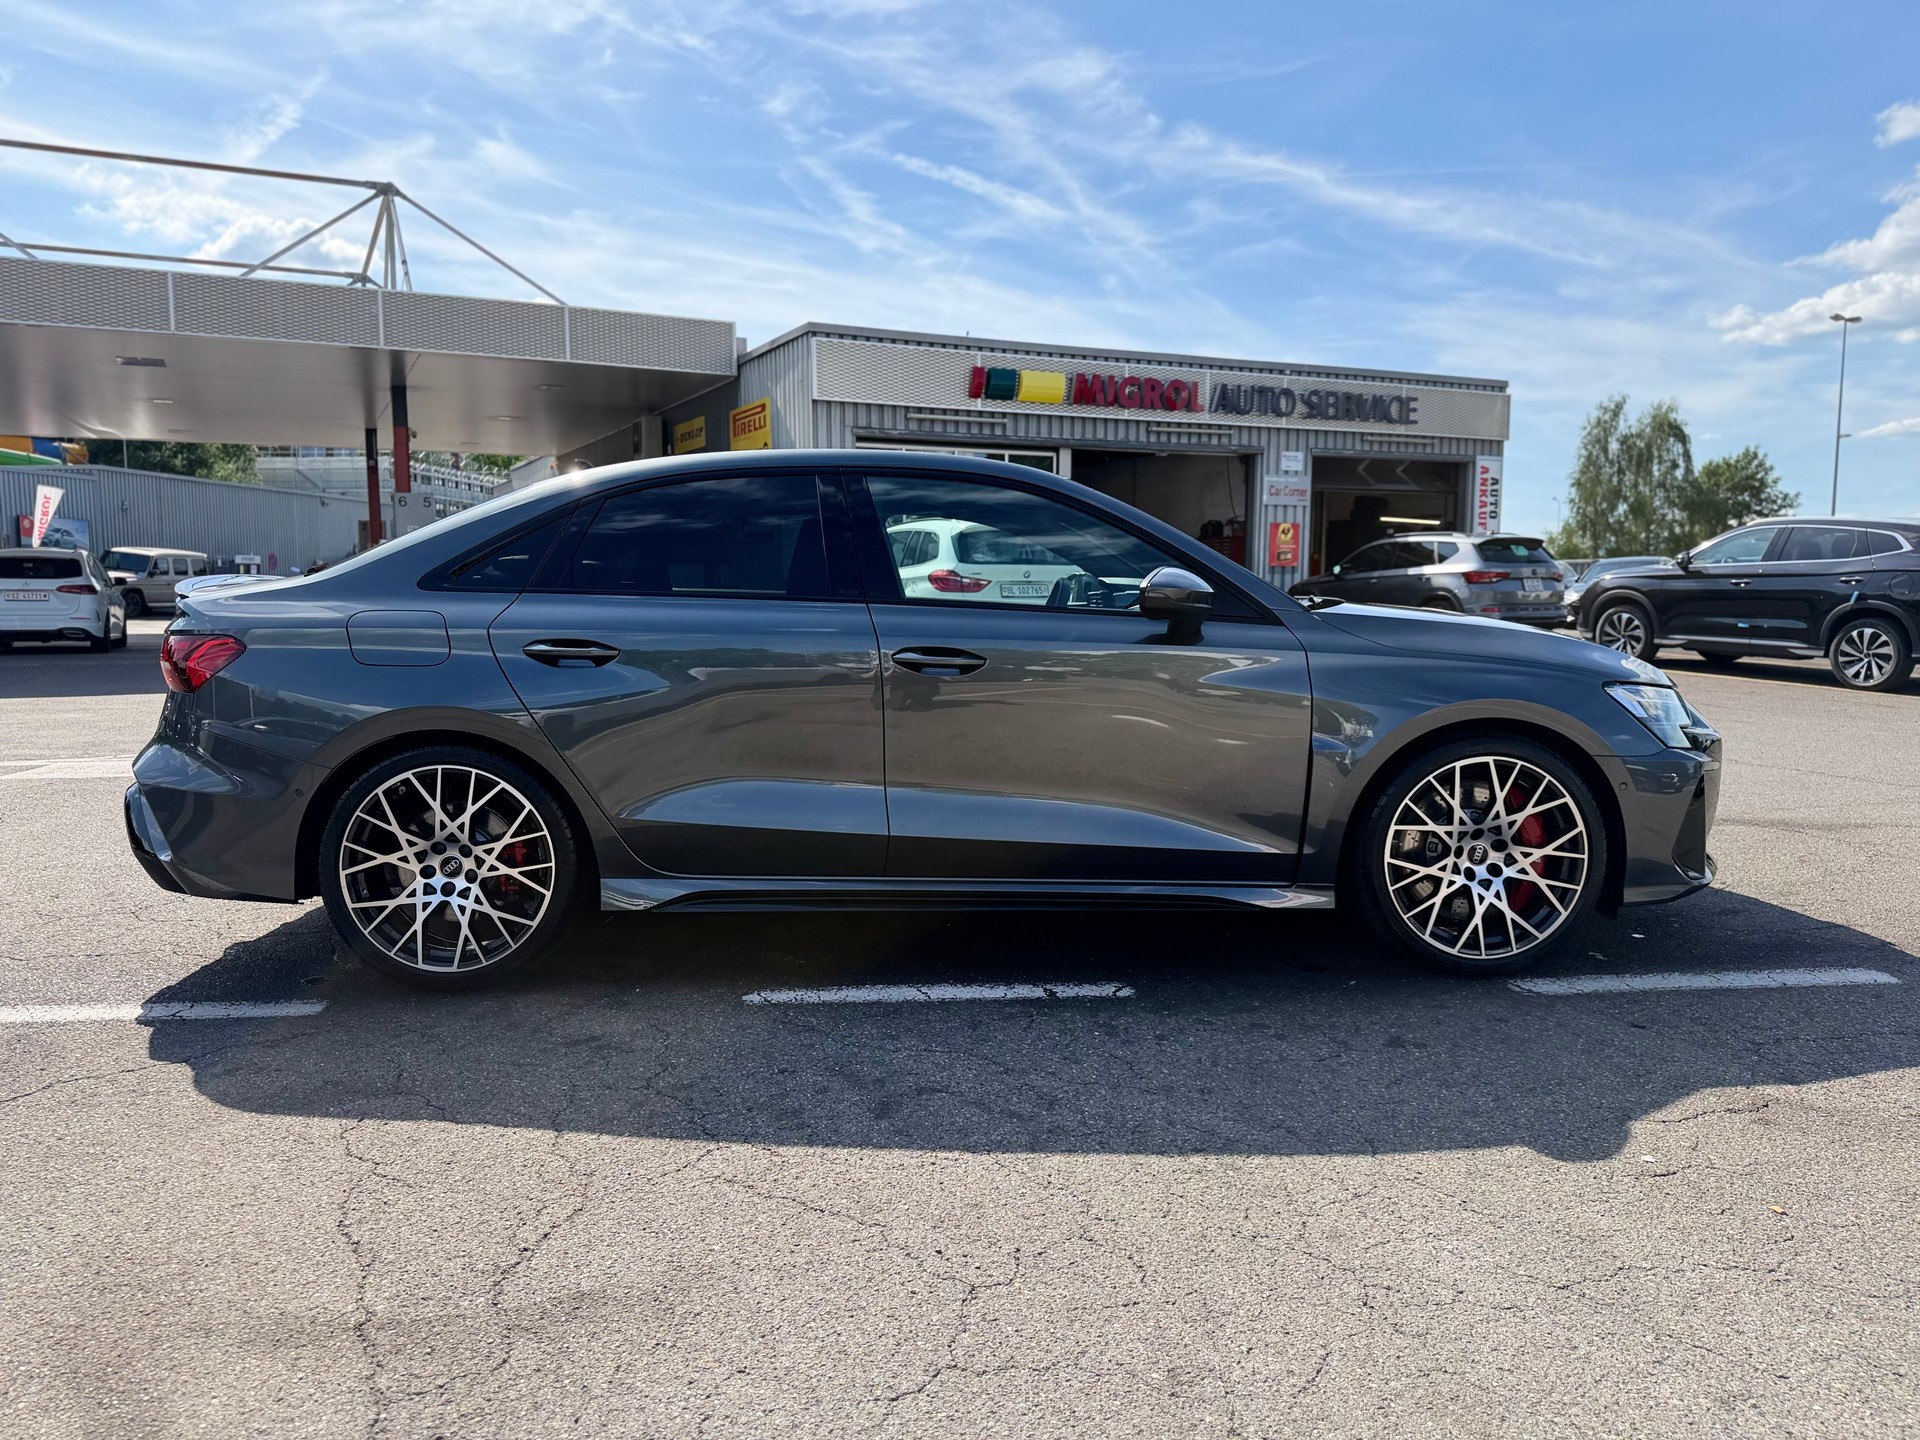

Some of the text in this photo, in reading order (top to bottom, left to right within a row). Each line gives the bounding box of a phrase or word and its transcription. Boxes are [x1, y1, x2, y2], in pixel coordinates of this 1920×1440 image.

[1072, 372, 1419, 425] MIGROL AUTO SERVICE
[679, 426, 704, 444] DUNLOP
[732, 402, 767, 438] PIRELLI
[398, 495, 432, 508] 6 5
[1269, 484, 1308, 498] Car Corner
[1477, 465, 1490, 530] ANKAUF
[1488, 476, 1499, 520] AUTO
